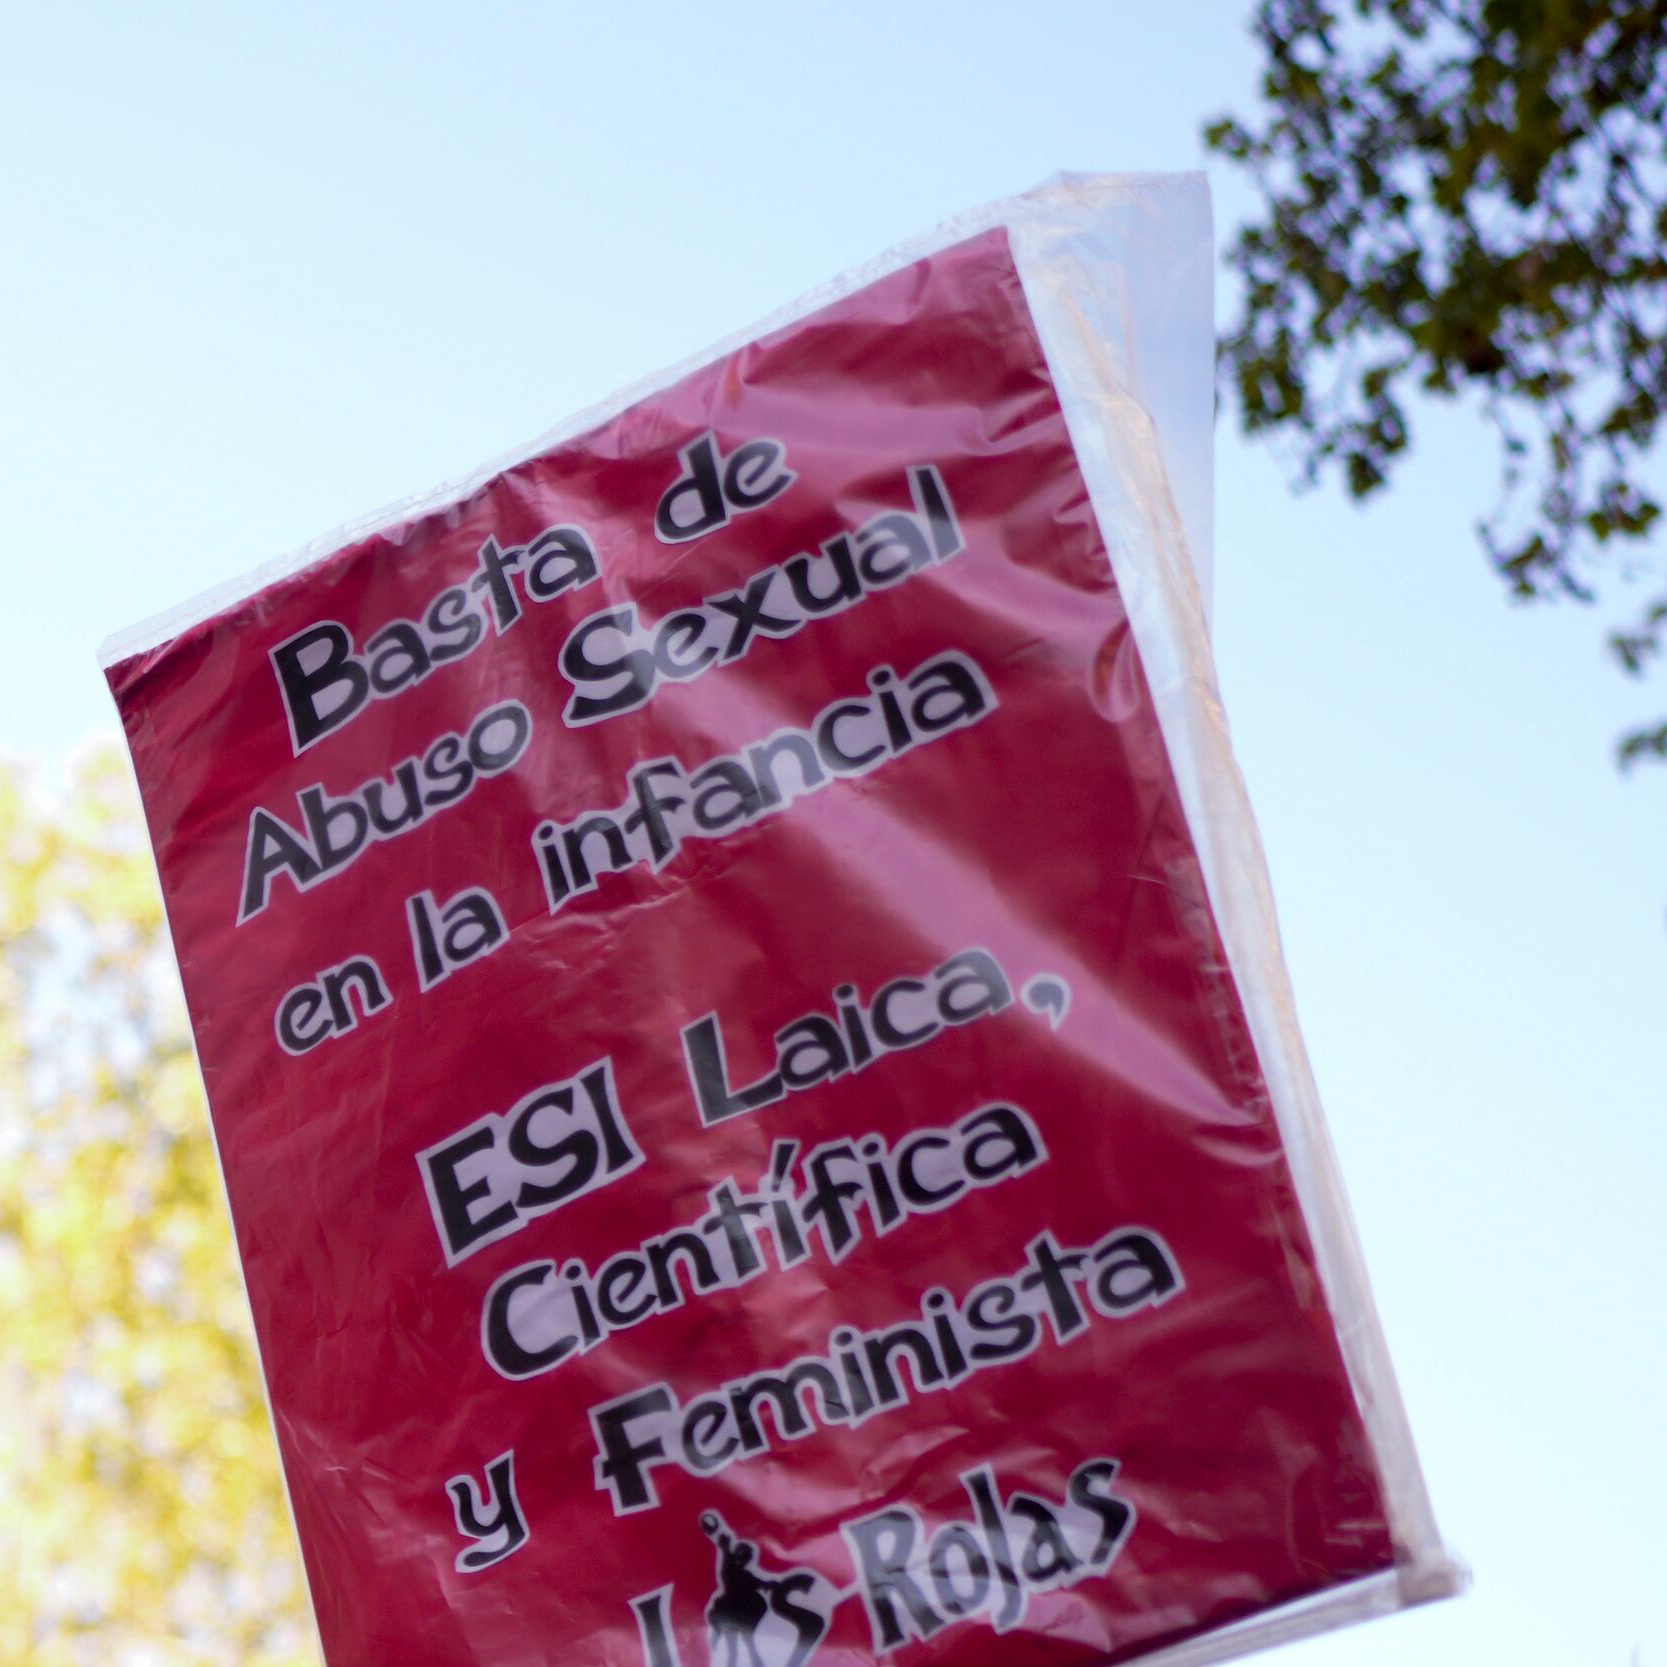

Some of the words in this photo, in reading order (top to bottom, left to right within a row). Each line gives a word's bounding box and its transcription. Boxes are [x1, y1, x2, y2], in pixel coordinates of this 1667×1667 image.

[236, 698, 533, 926] Abuso
[557, 465, 966, 729] Sexual
[270, 522, 599, 757] Basta
[653, 430, 798, 545] de
[274, 955, 393, 1057] en
[404, 886, 509, 993] la
[530, 649, 999, 914] infancia
[417, 1058, 644, 1265] ESI
[681, 948, 1069, 1127] Laica,
[482, 1101, 1047, 1379] Científica
[445, 1450, 528, 1573] y
[588, 1226, 1183, 1514] Feminista
